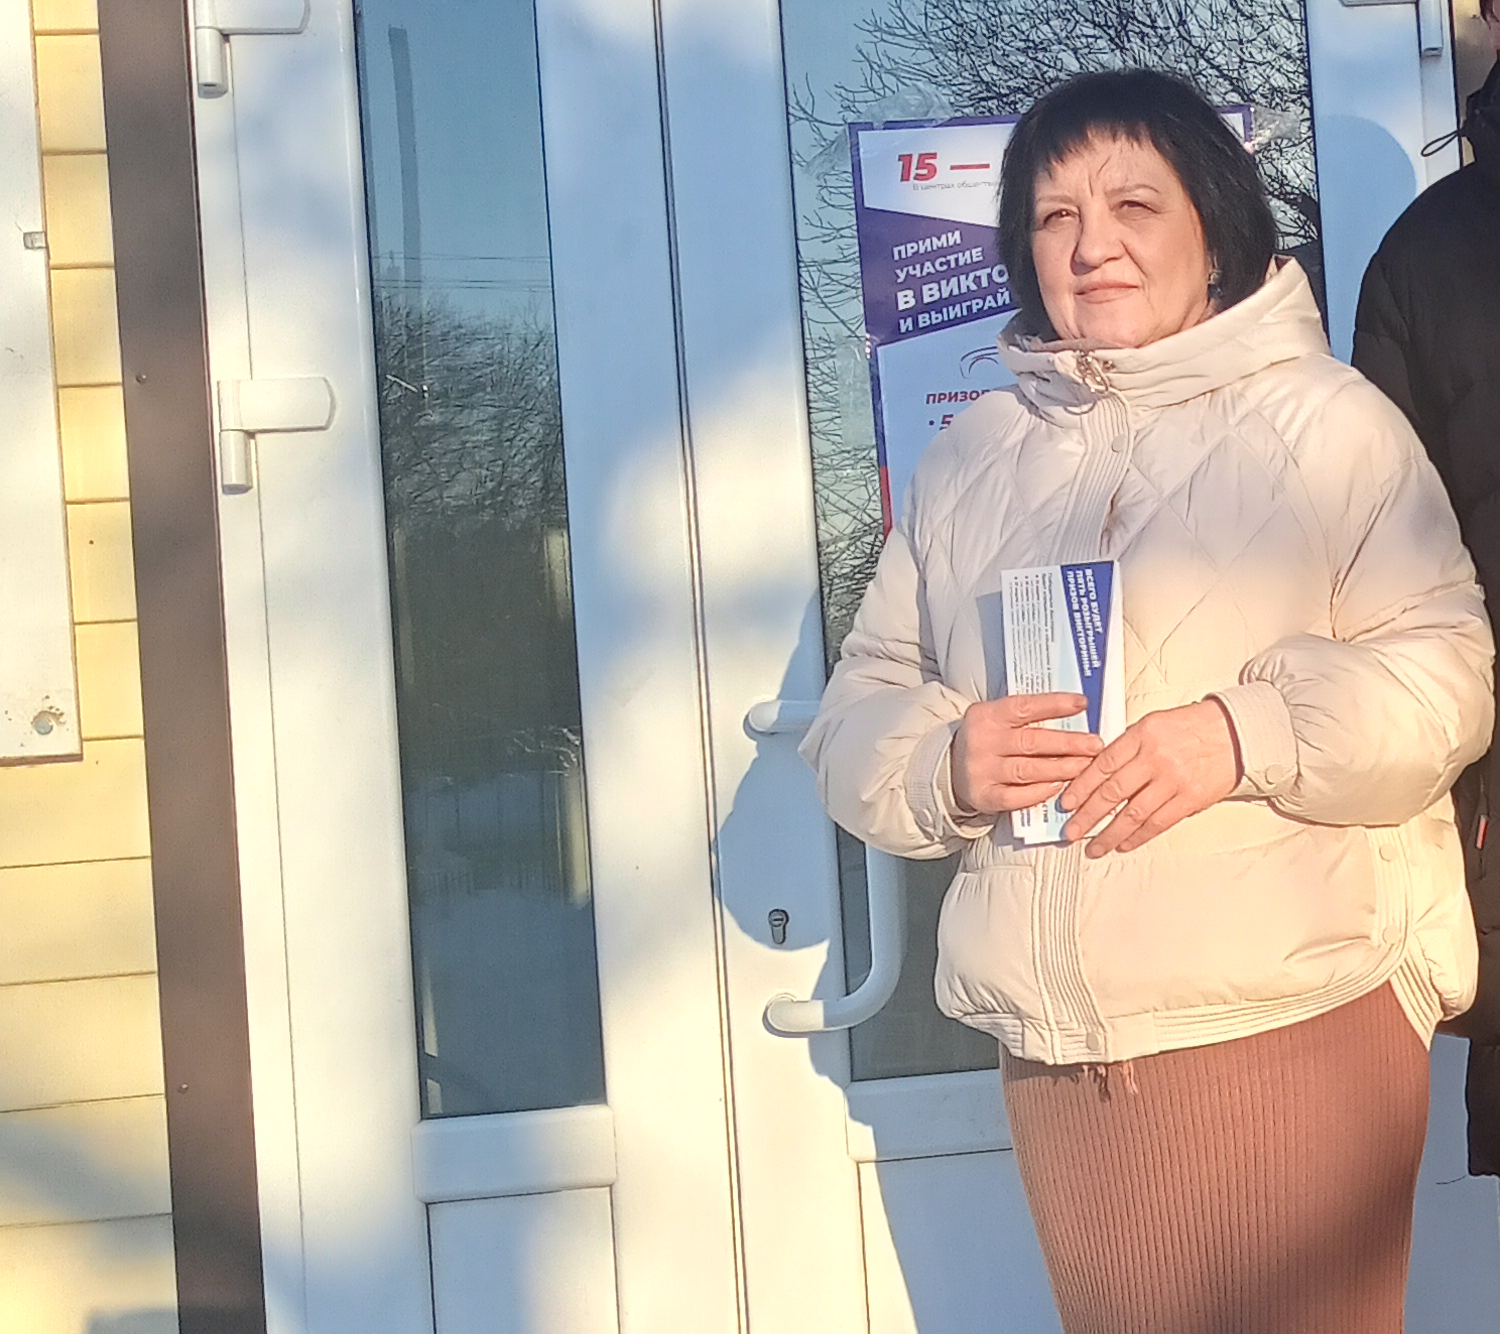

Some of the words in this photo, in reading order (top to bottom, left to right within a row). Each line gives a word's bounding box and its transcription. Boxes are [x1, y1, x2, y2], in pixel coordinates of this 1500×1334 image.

[898, 152, 938, 182] 15
[892, 230, 962, 261] ПРИМИ
[895, 247, 985, 284] УЧАСТИЕ
[896, 289, 916, 311] В
[898, 318, 914, 334] И
[917, 287, 1011, 329] ВЫИГРАЙ
